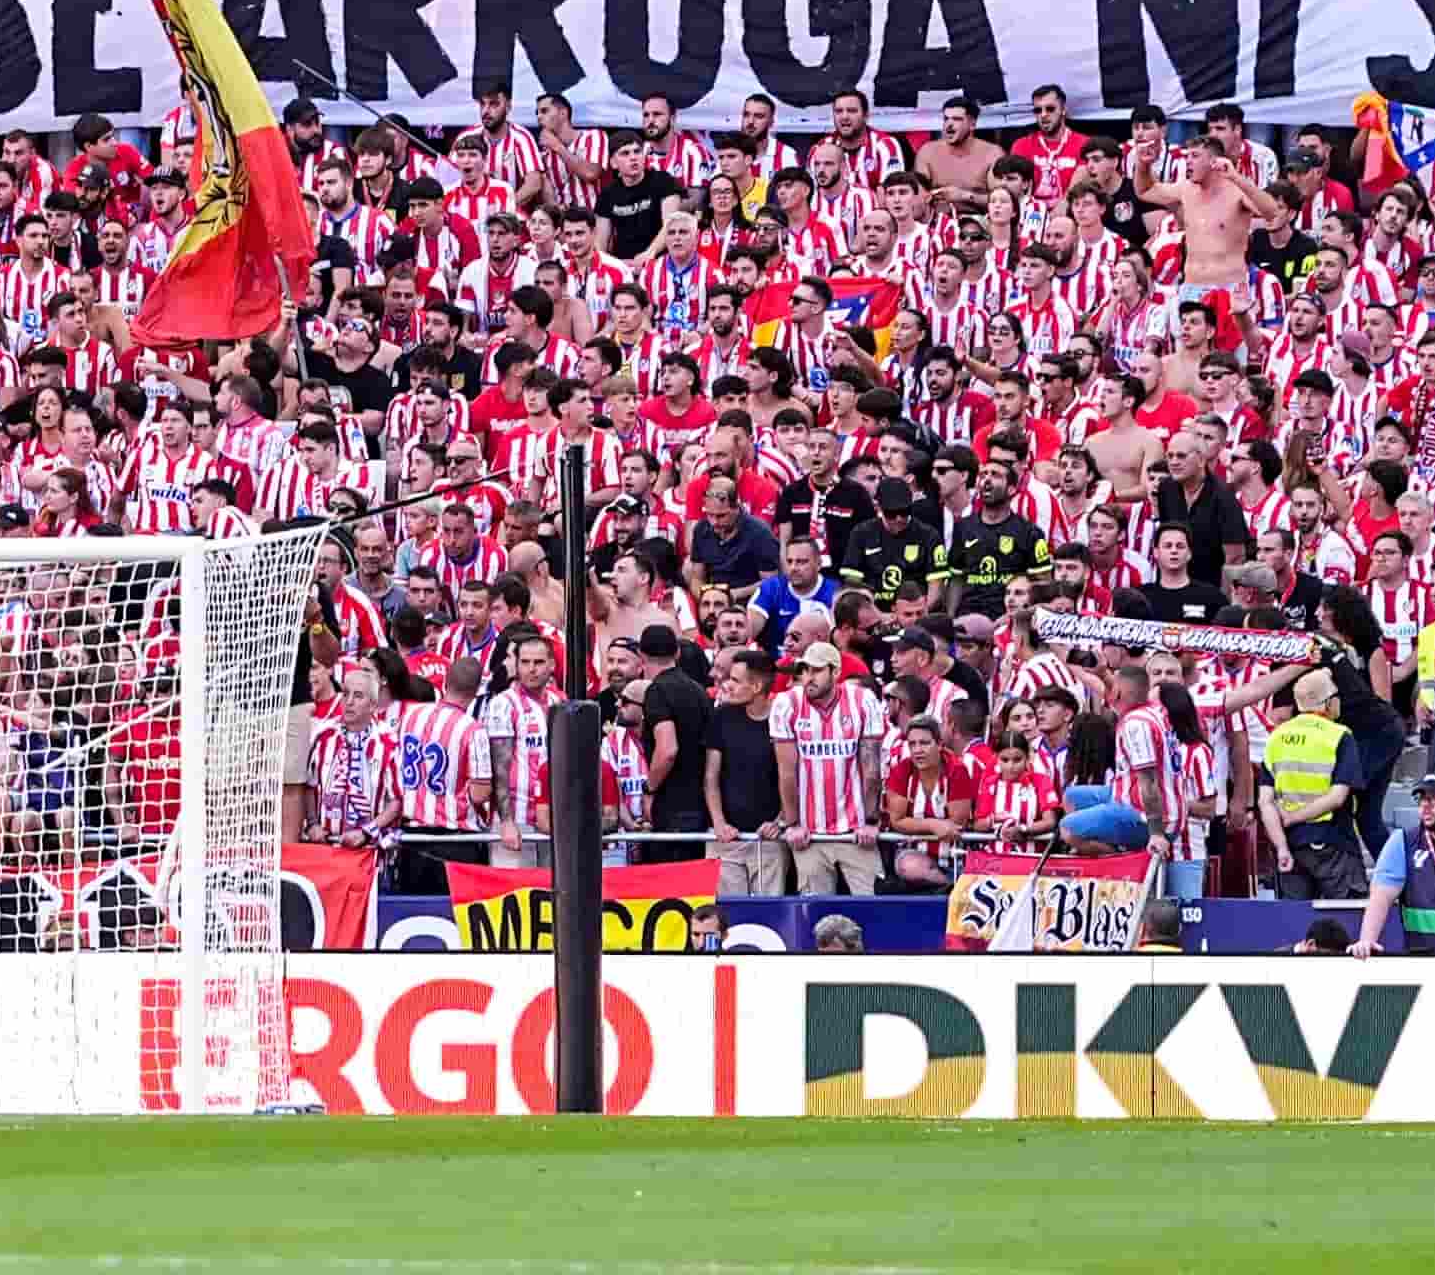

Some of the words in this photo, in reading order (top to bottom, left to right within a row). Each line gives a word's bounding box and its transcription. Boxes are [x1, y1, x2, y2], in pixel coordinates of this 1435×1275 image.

[402, 732, 449, 797] 82
[138, 977, 653, 1117] ERGO
[804, 981, 1423, 1119] DKV
